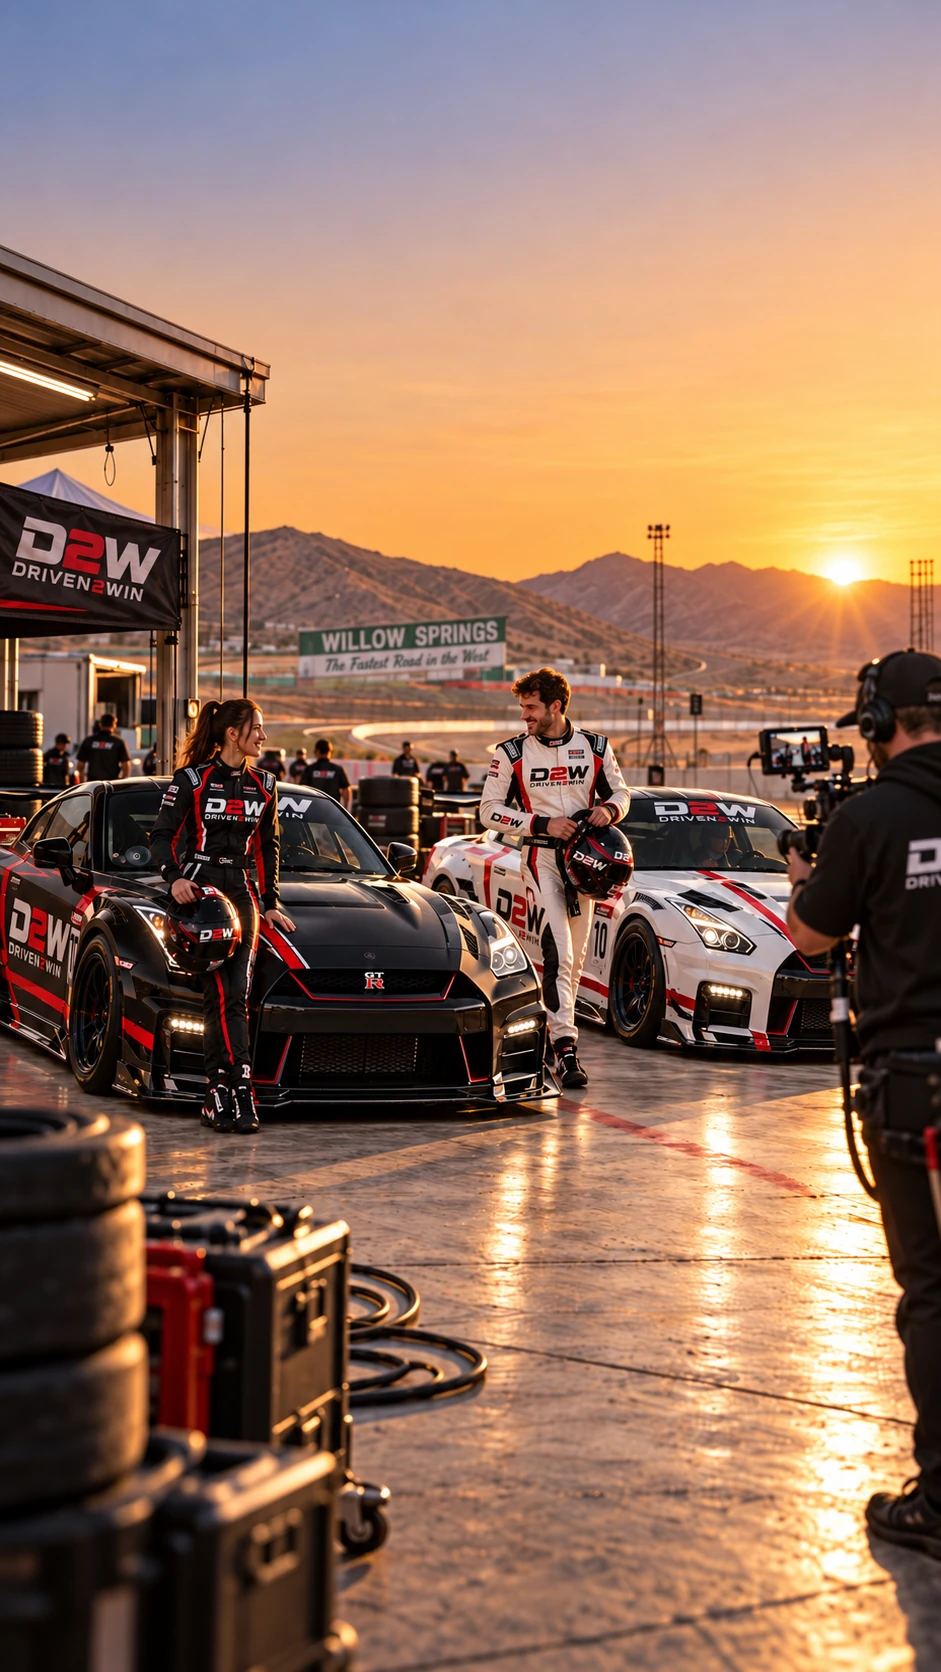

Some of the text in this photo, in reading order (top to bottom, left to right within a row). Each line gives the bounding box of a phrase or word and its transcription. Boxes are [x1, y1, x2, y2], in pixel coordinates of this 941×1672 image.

[16, 516, 161, 585] D2W
[12, 561, 144, 602] DRIVEN2WIN
[321, 620, 499, 653] WILLOW SPRINGS
[325, 648, 490, 673] The Fastest Road in the West
[530, 765, 590, 782] D2W
[204, 797, 266, 817] D2W
[653, 801, 757, 819] D2W
[490, 812, 524, 829] D2W
[659, 815, 756, 824] DRIVEN2WIN
[572, 850, 607, 871] D2W
[496, 887, 546, 936] D2W
[9, 897, 71, 963] D2W
[199, 927, 234, 940] D2W
[594, 920, 608, 959] 10
[8, 941, 62, 979] DRIVEN2WIN
[364, 971, 385, 979] GT
[364, 977, 385, 989] R
